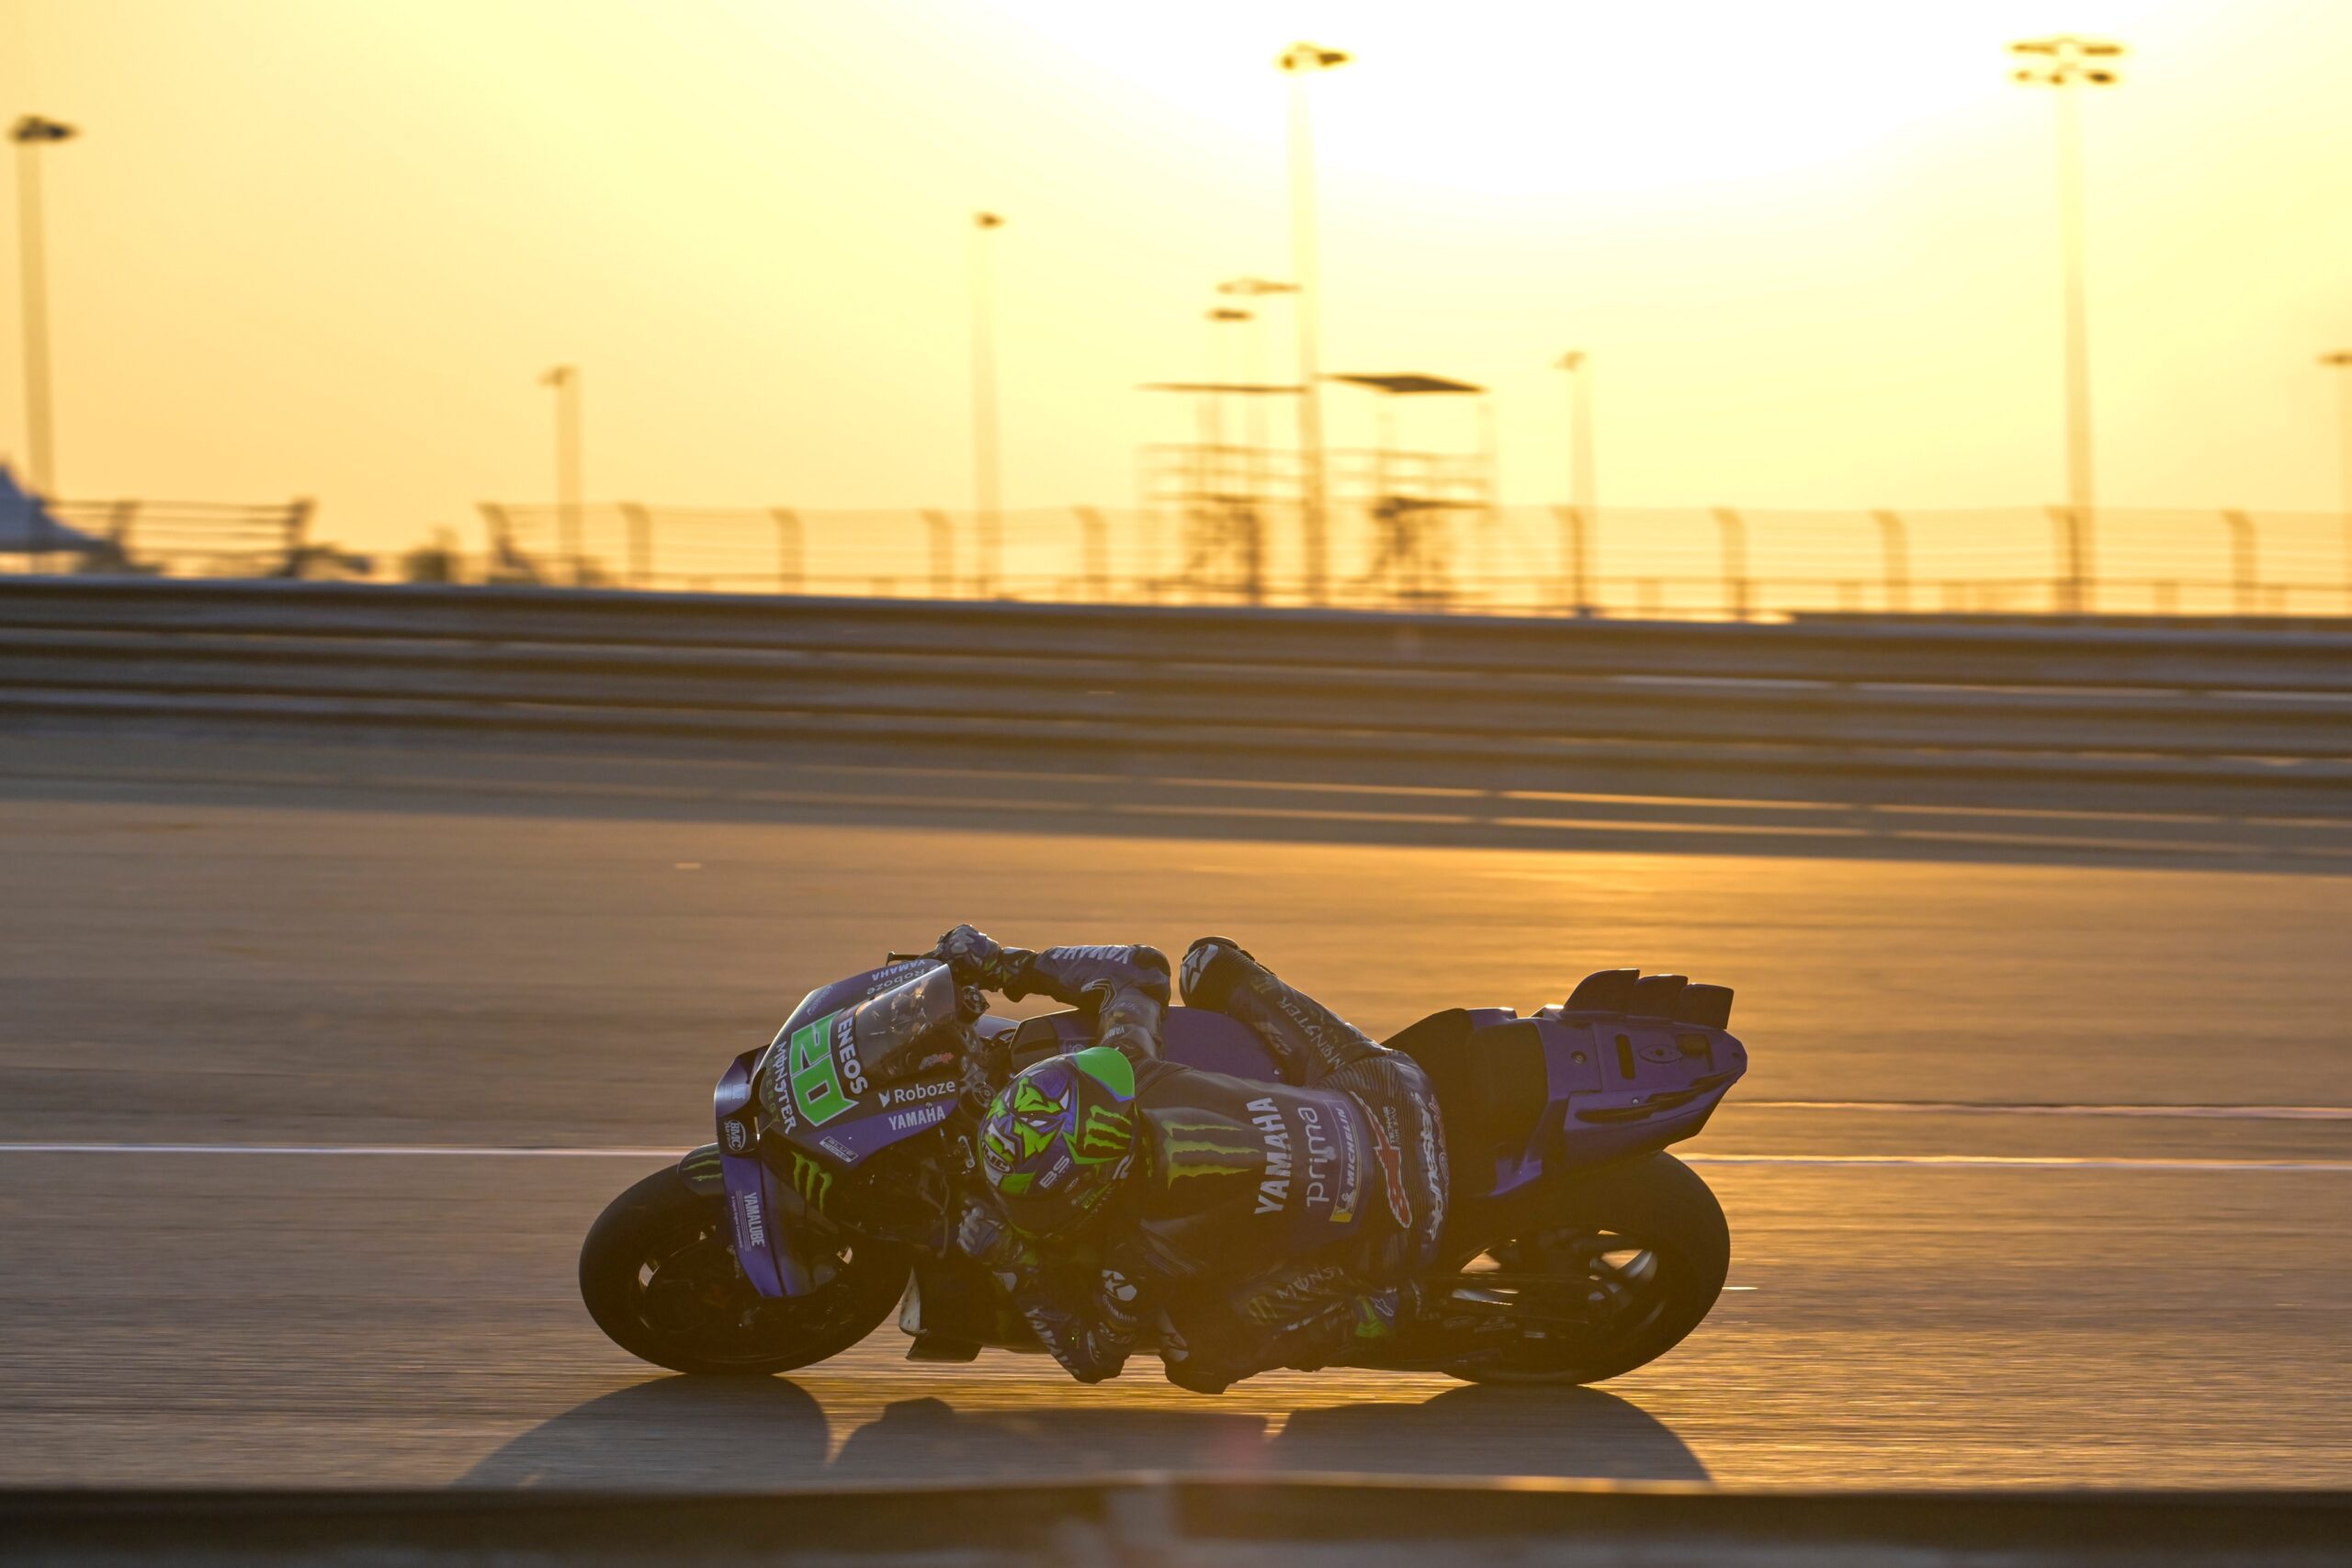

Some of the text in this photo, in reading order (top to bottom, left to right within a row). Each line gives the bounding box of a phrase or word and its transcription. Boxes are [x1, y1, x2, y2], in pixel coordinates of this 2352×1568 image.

[865, 969, 925, 996] Roboze
[871, 960, 926, 983] YAMAHA
[837, 1016, 869, 1095] ENEOS
[1276, 996, 1347, 1071] MONSTER
[772, 1041, 797, 1135] MONSTER
[789, 1007, 861, 1128] 20
[893, 1079, 956, 1104] Roboze
[729, 1122, 741, 1148] BMC
[887, 1105, 946, 1132] YAMAHA
[1337, 1106, 1357, 1188] MICHELIN
[1038, 1155, 1069, 1189] BS
[1246, 1097, 1294, 1215] YAMAHA
[1297, 1106, 1330, 1209] prima
[743, 1190, 765, 1247] YAMALUBE
